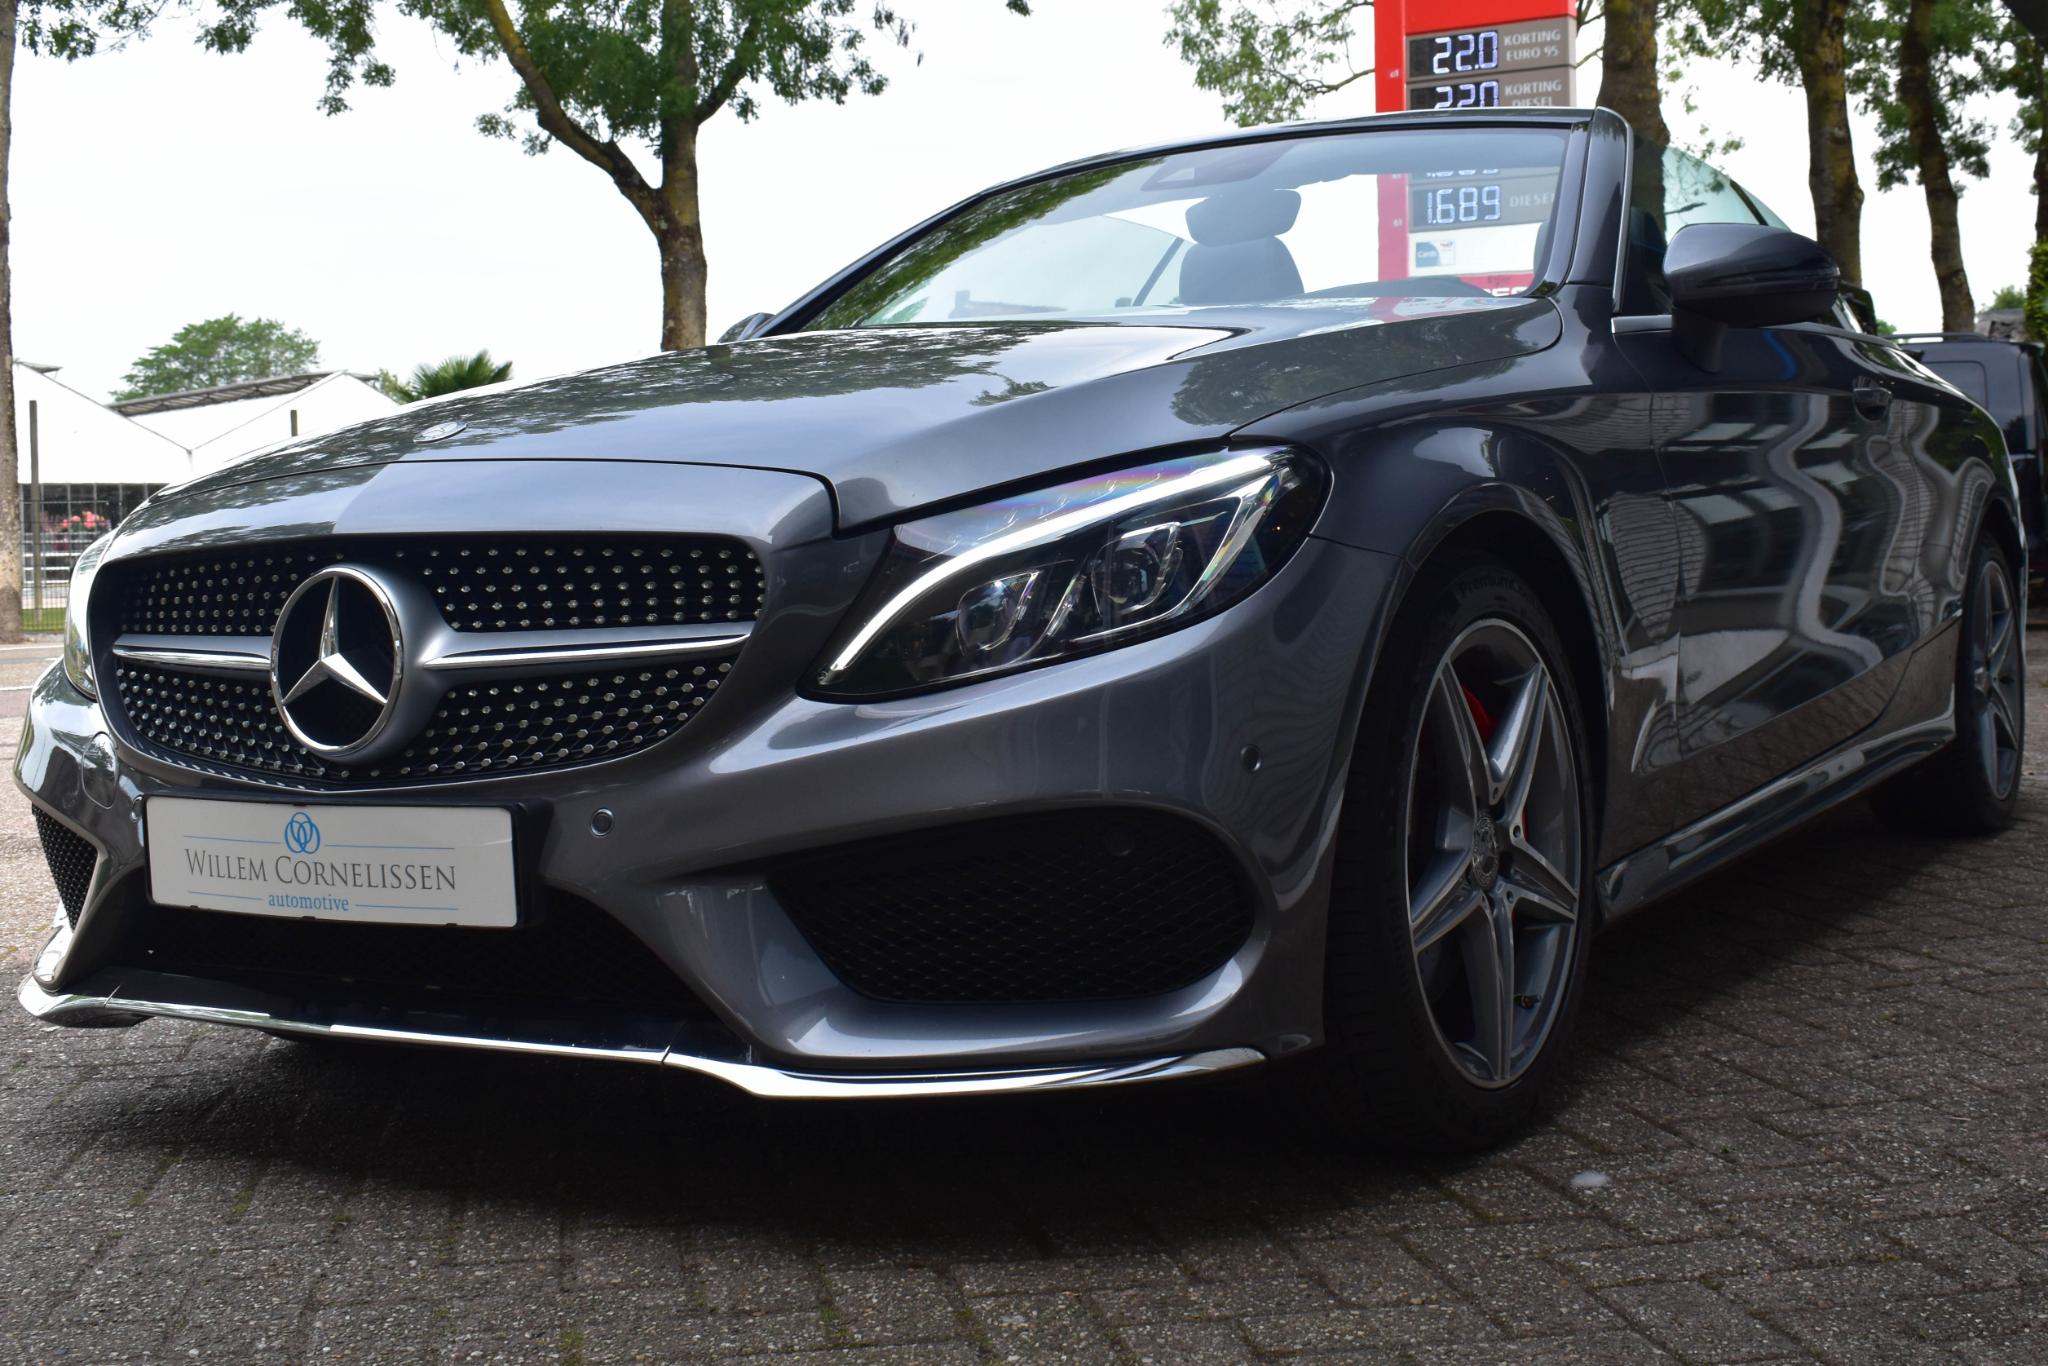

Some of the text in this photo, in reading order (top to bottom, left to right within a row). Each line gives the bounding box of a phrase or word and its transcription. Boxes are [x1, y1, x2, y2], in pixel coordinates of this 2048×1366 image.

[1503, 29, 1561, 47] KORTING
[1432, 31, 1499, 74] 22.0
[1506, 45, 1559, 62] EURO 95
[1504, 80, 1563, 97] KORTING
[1427, 185, 1501, 225] 1.689
[185, 848, 457, 892] WILLEM CORNELISSEN
[268, 892, 350, 912] automotive
